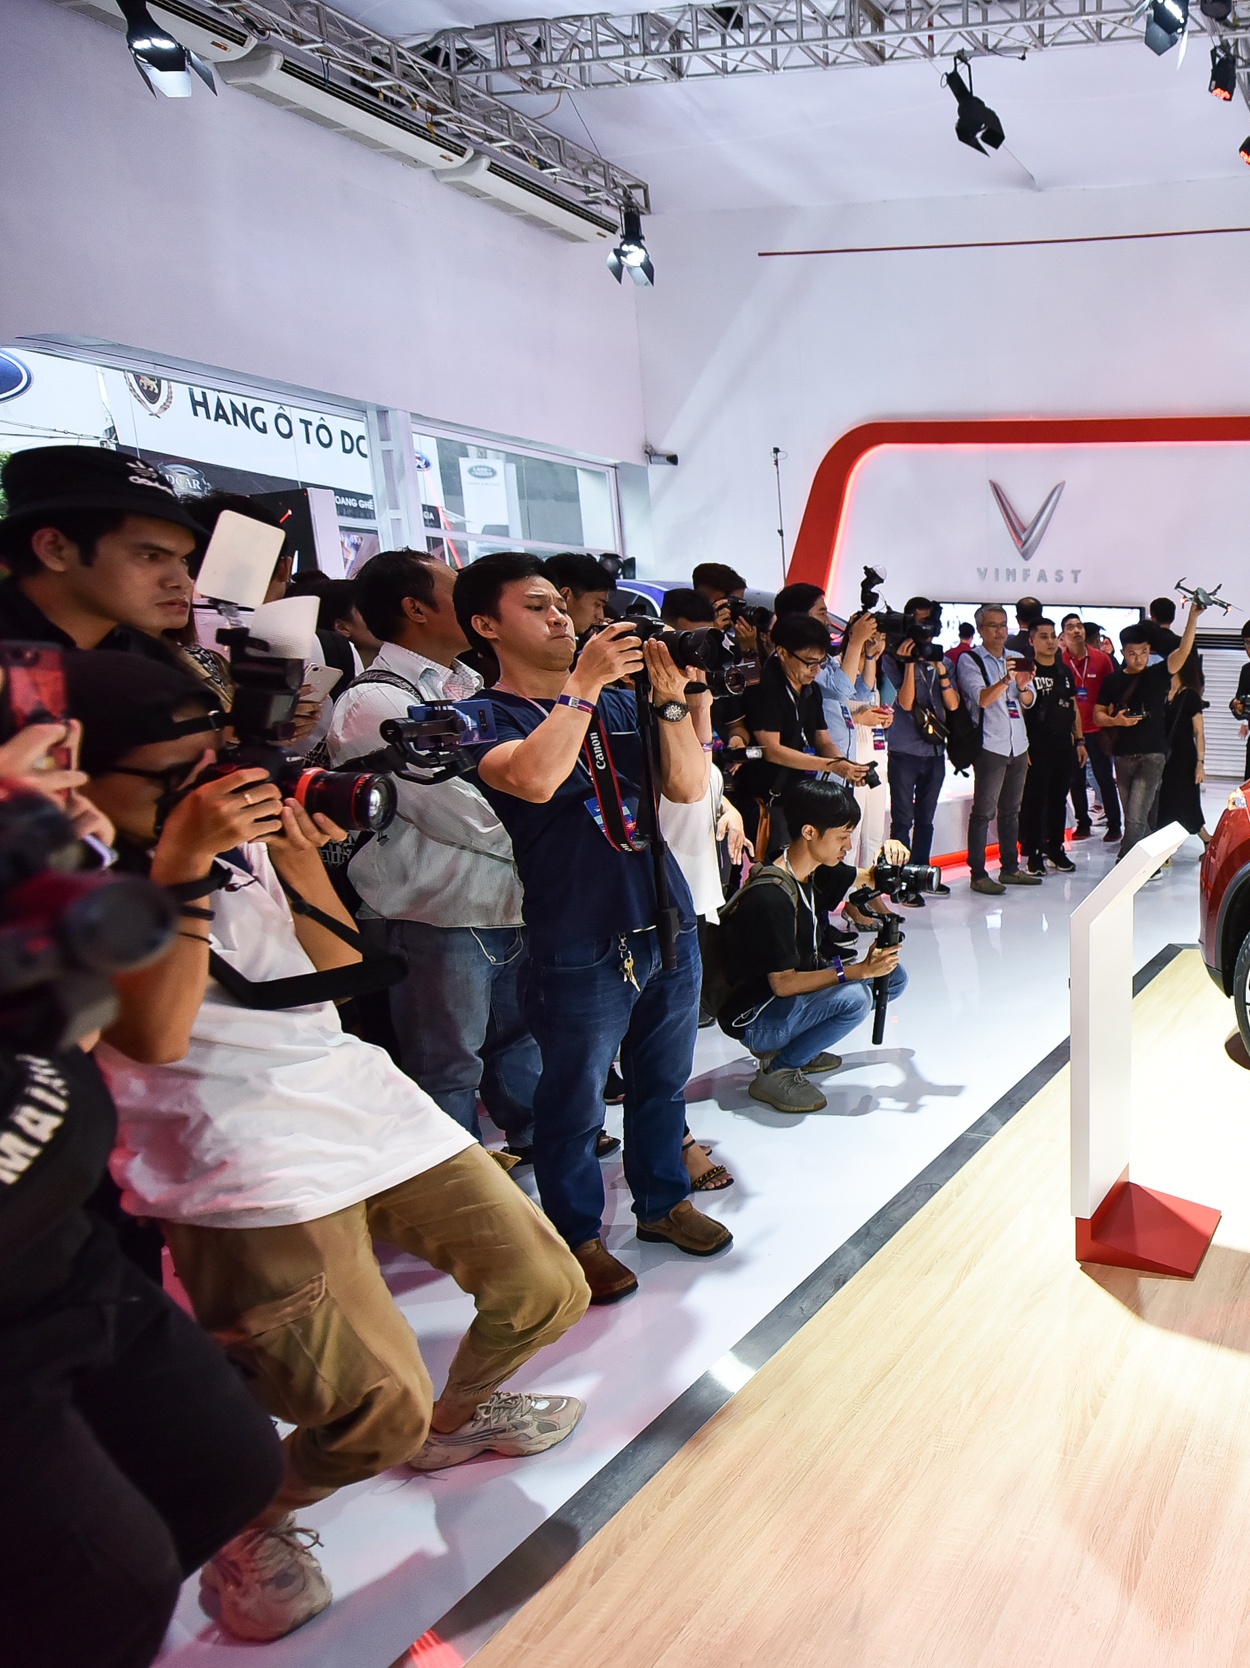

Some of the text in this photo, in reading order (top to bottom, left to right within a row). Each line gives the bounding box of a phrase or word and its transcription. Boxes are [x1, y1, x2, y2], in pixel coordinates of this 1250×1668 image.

[274, 405, 293, 440] Ô
[299, 416, 333, 449] TÔ
[976, 566, 1082, 584] VINFAST
[589, 731, 607, 770] Canon
